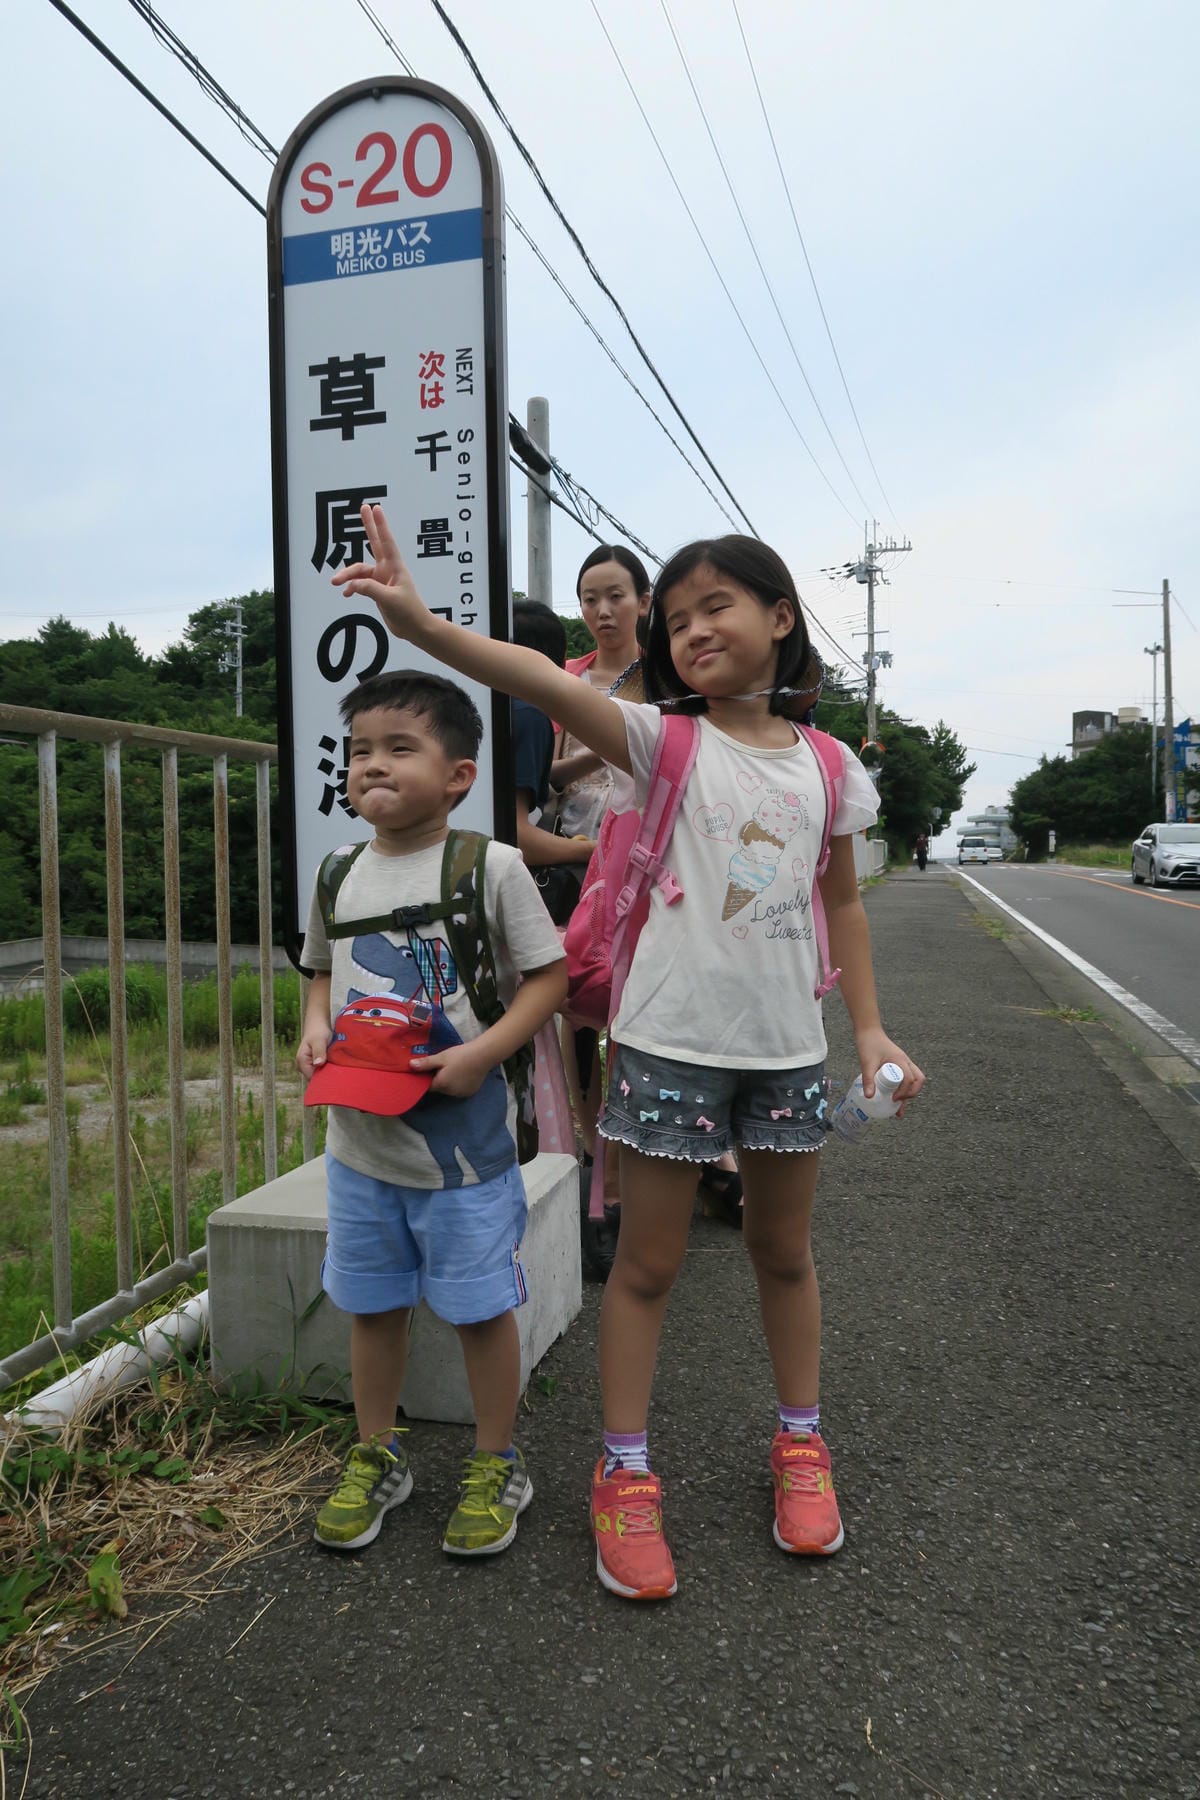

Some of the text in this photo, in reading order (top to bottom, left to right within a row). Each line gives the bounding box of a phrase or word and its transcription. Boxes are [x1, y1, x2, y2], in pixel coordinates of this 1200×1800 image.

[300, 122, 453, 214] S-20
[330, 220, 431, 259] 明光バス
[336, 249, 425, 275] MEIKO BUS
[418, 350, 446, 409] 次は
[455, 347, 478, 626] NEXT Senjo-guch
[750, 888, 810, 923] Lovely
[765, 919, 812, 940] Sweets
